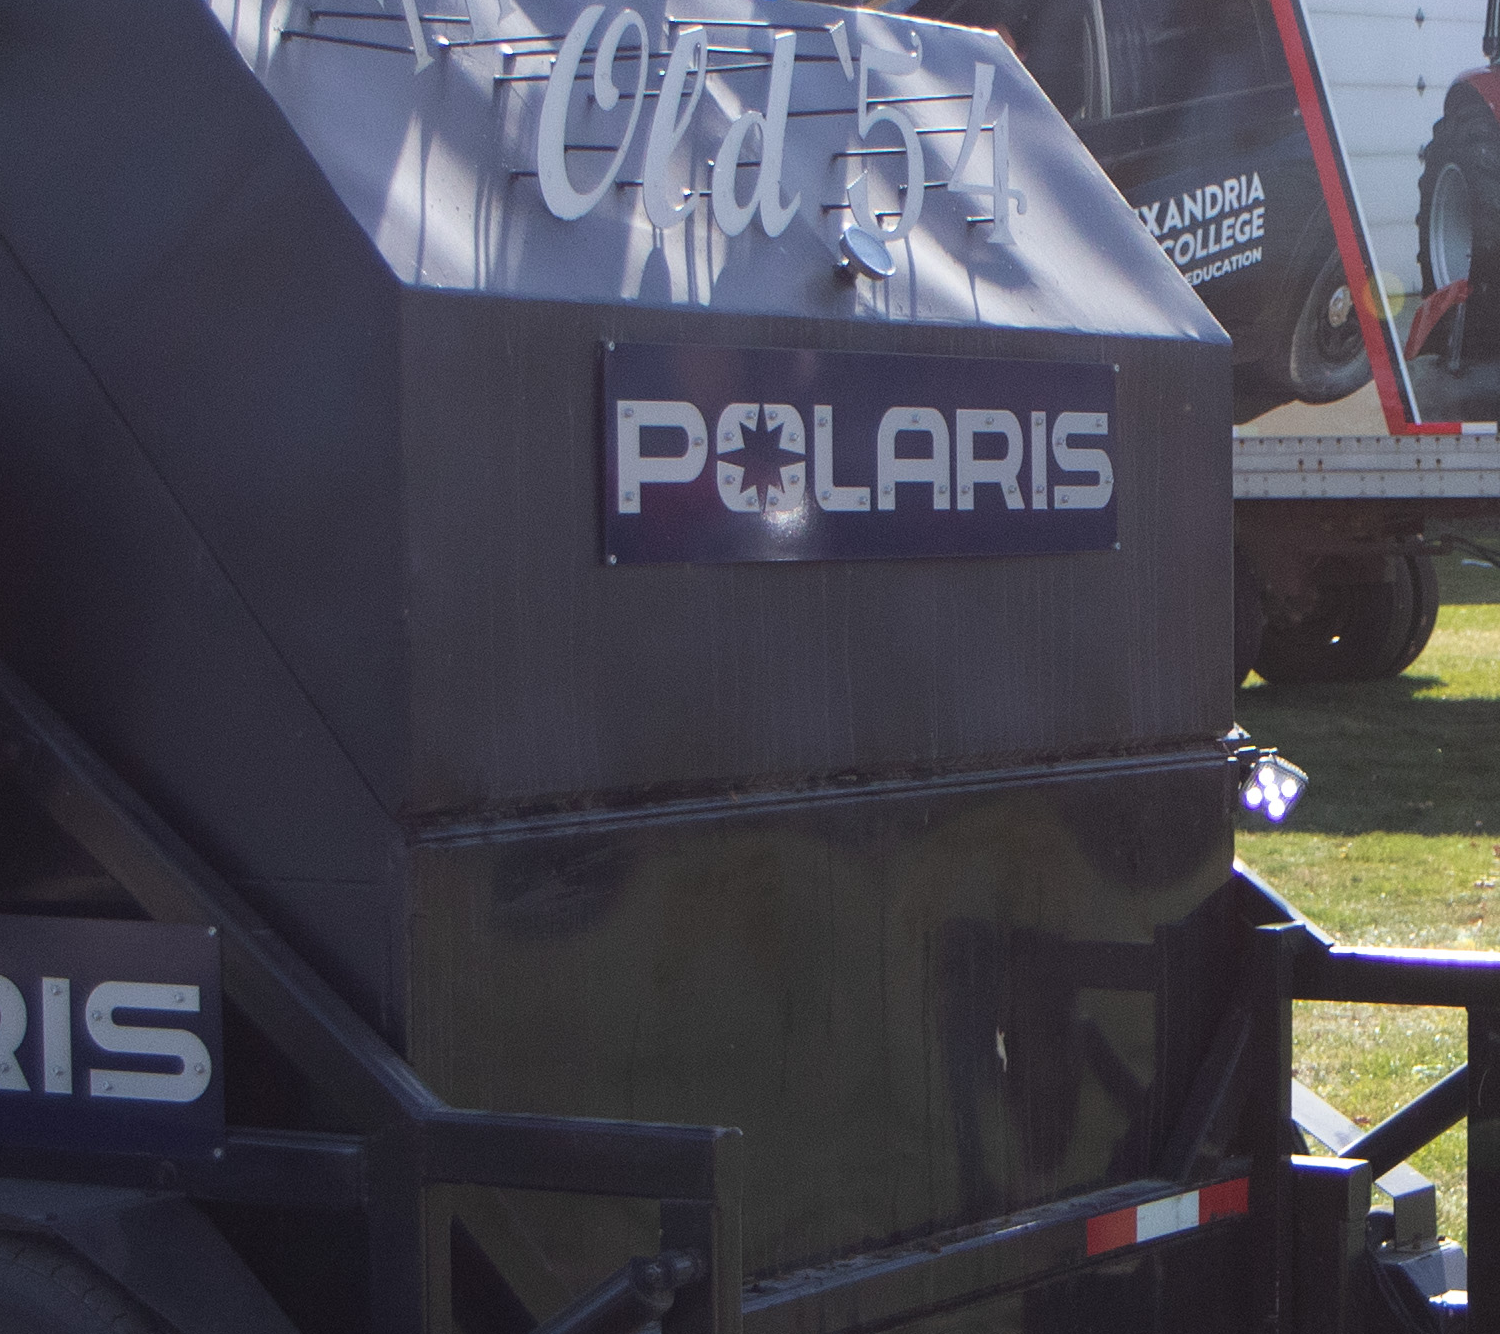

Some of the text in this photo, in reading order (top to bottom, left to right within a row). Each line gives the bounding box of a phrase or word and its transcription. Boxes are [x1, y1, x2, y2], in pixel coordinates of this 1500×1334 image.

[537, 5, 802, 238] Old
[1134, 171, 1266, 238] XANDRIA
[616, 397, 1116, 517] POLARIS
